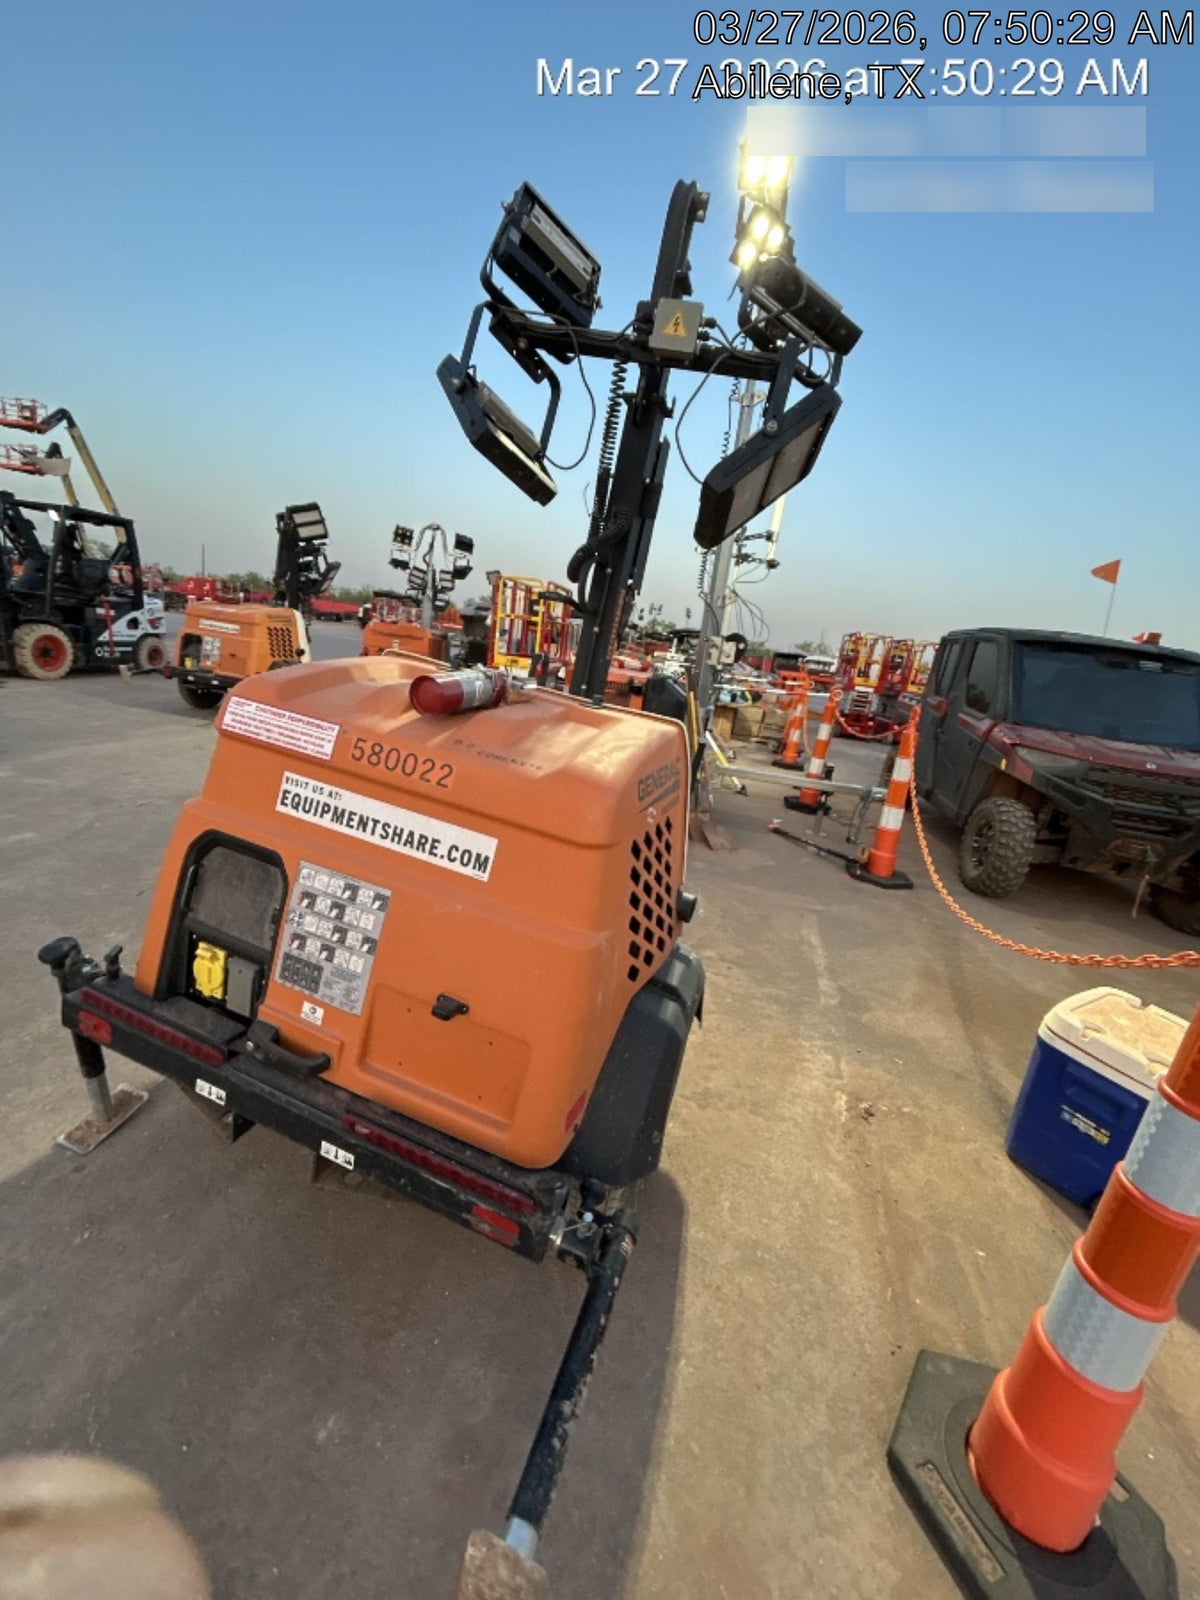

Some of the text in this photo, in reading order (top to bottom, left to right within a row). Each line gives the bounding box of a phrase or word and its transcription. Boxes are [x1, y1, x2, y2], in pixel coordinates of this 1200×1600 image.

[284, 775, 343, 801] VISIT US AT:
[351, 737, 454, 788] 580022
[280, 788, 490, 874] EQUIPMENTSHARE.COM
